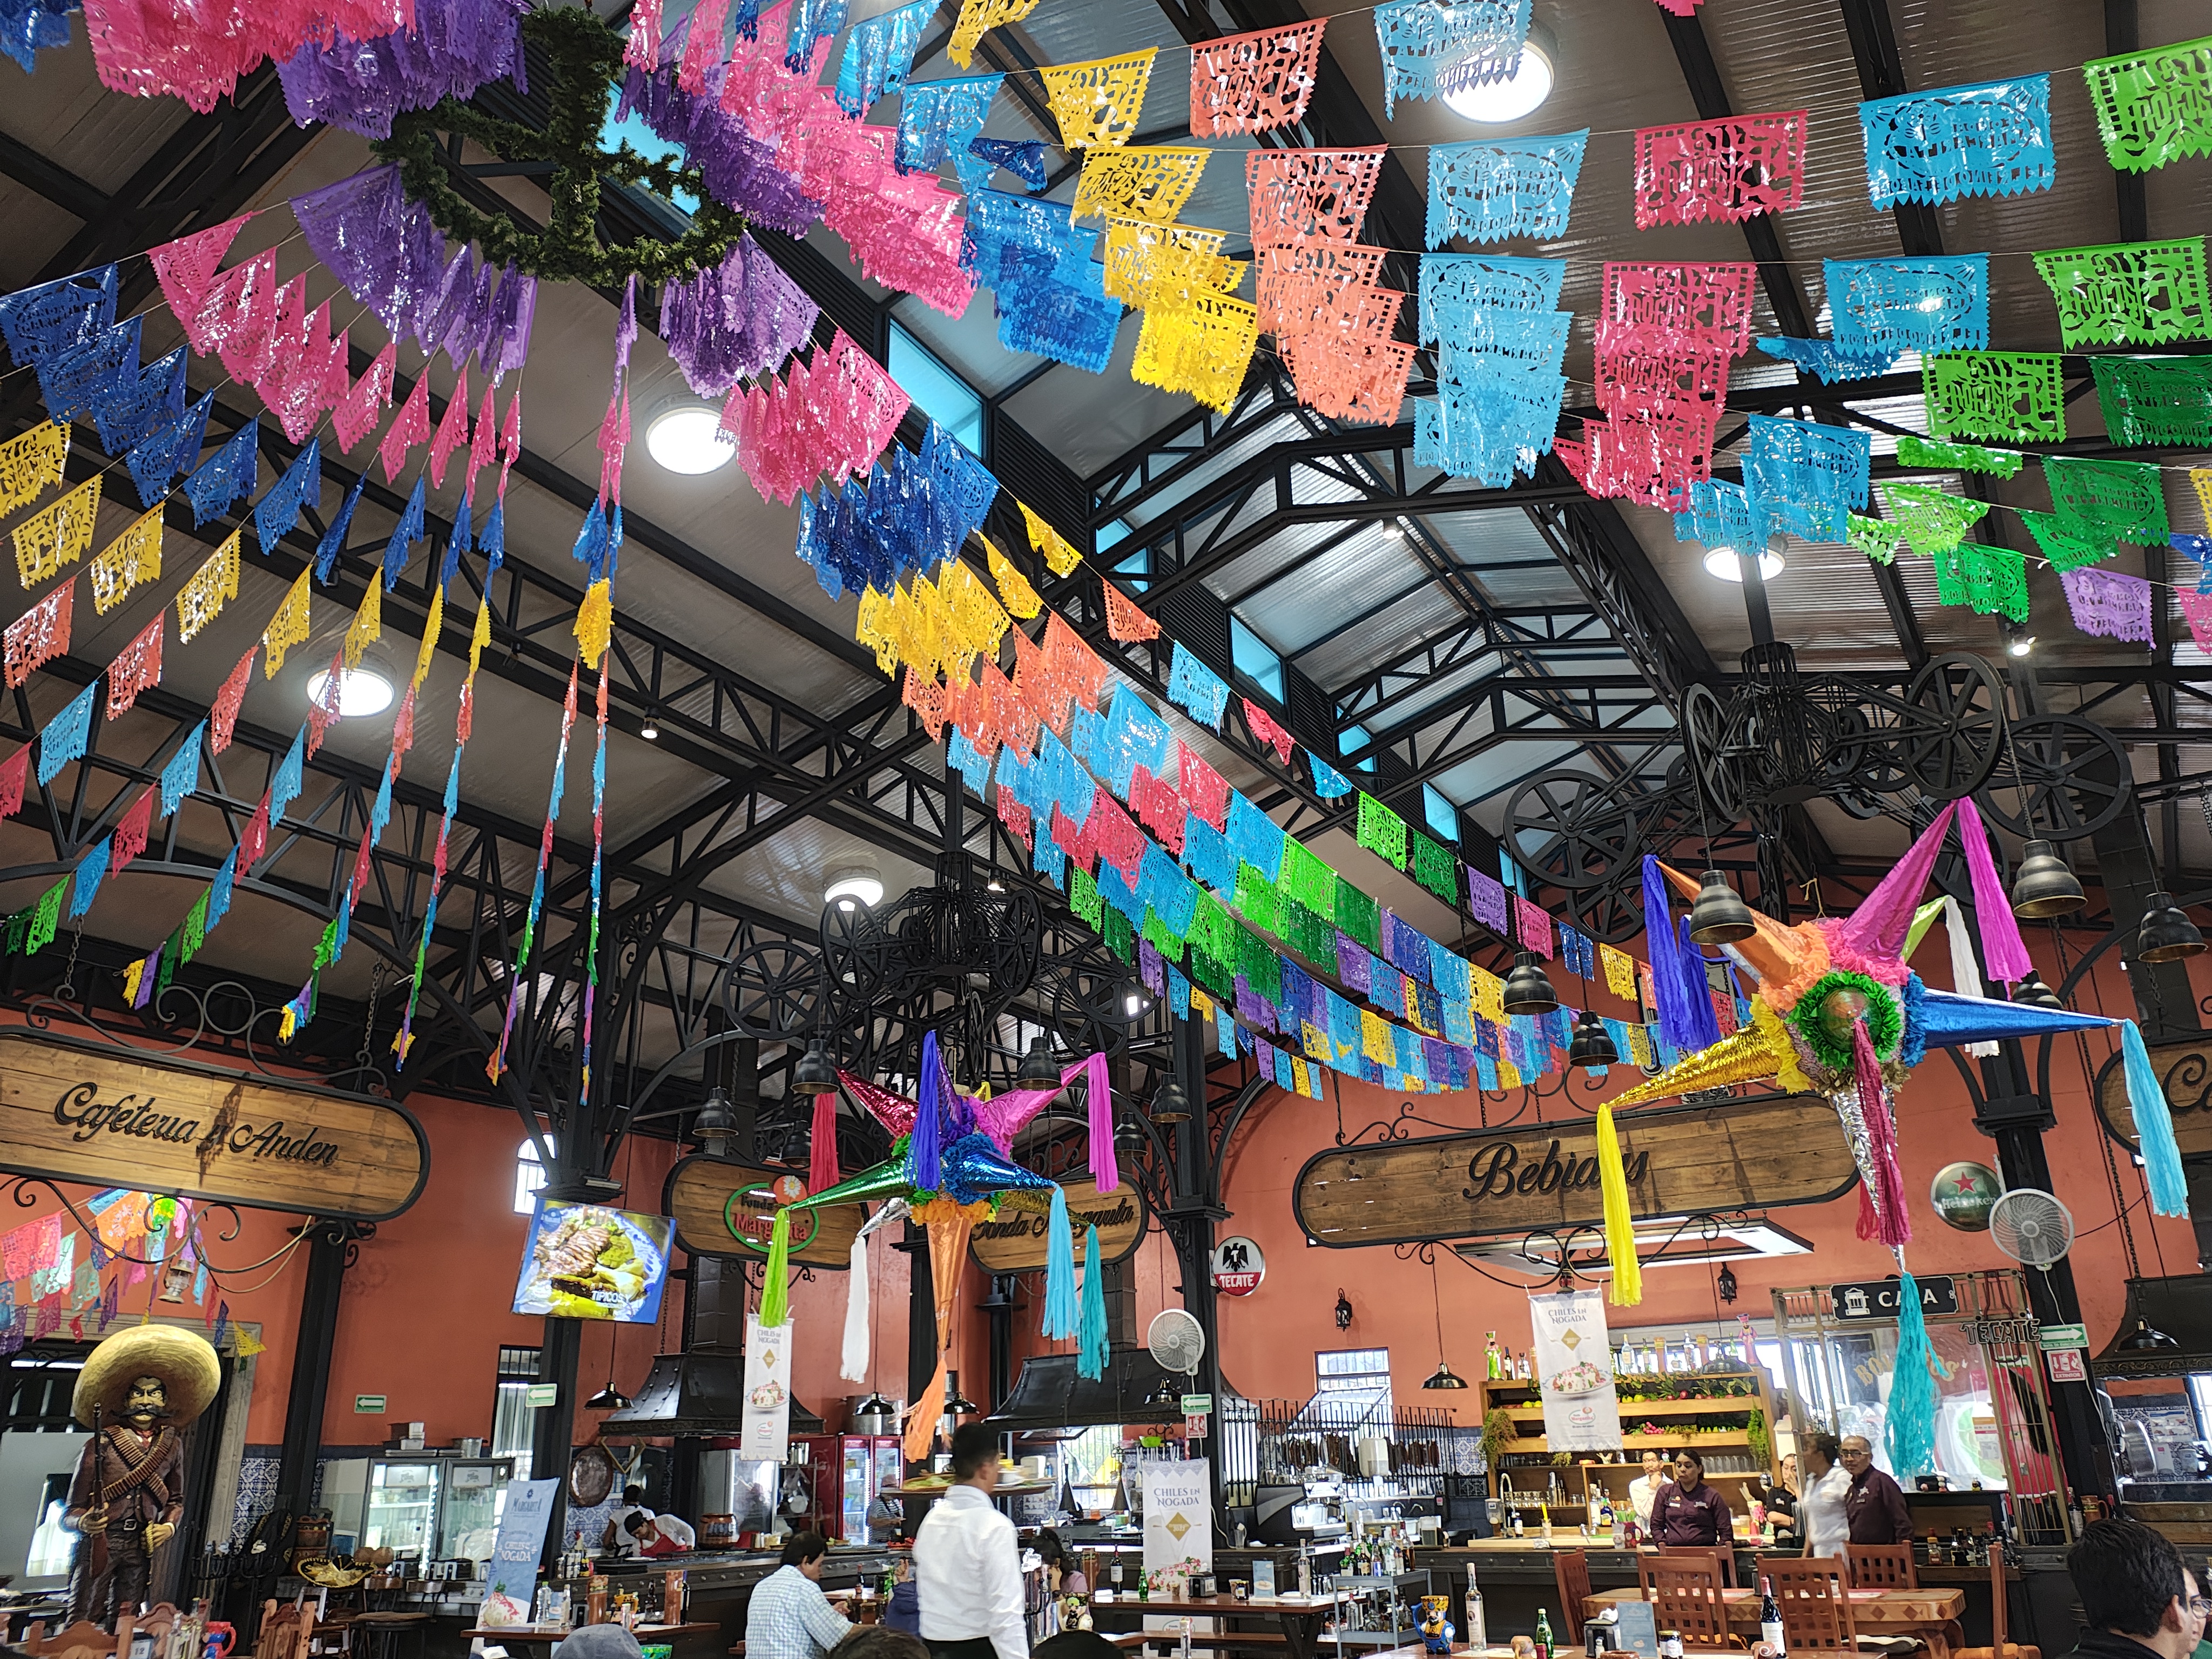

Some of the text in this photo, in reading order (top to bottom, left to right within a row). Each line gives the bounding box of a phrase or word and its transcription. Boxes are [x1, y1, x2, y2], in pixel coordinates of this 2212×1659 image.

[229, 1121, 339, 1166] Anden
[1462, 1139, 1649, 1200] Bebids
[1941, 1196, 1996, 1209] Heineken
[735, 1213, 807, 1240] Margita
[1219, 1274, 1255, 1288] TECATE
[1878, 1288, 1939, 1307] CA
[1550, 1314, 1587, 1325] NOGADA
[1959, 1318, 2042, 1345] TECATE
[1154, 1488, 1188, 1496] CHILES
[1155, 1496, 1199, 1508] NOGADA
[134, 1647, 145, 1656] 12
